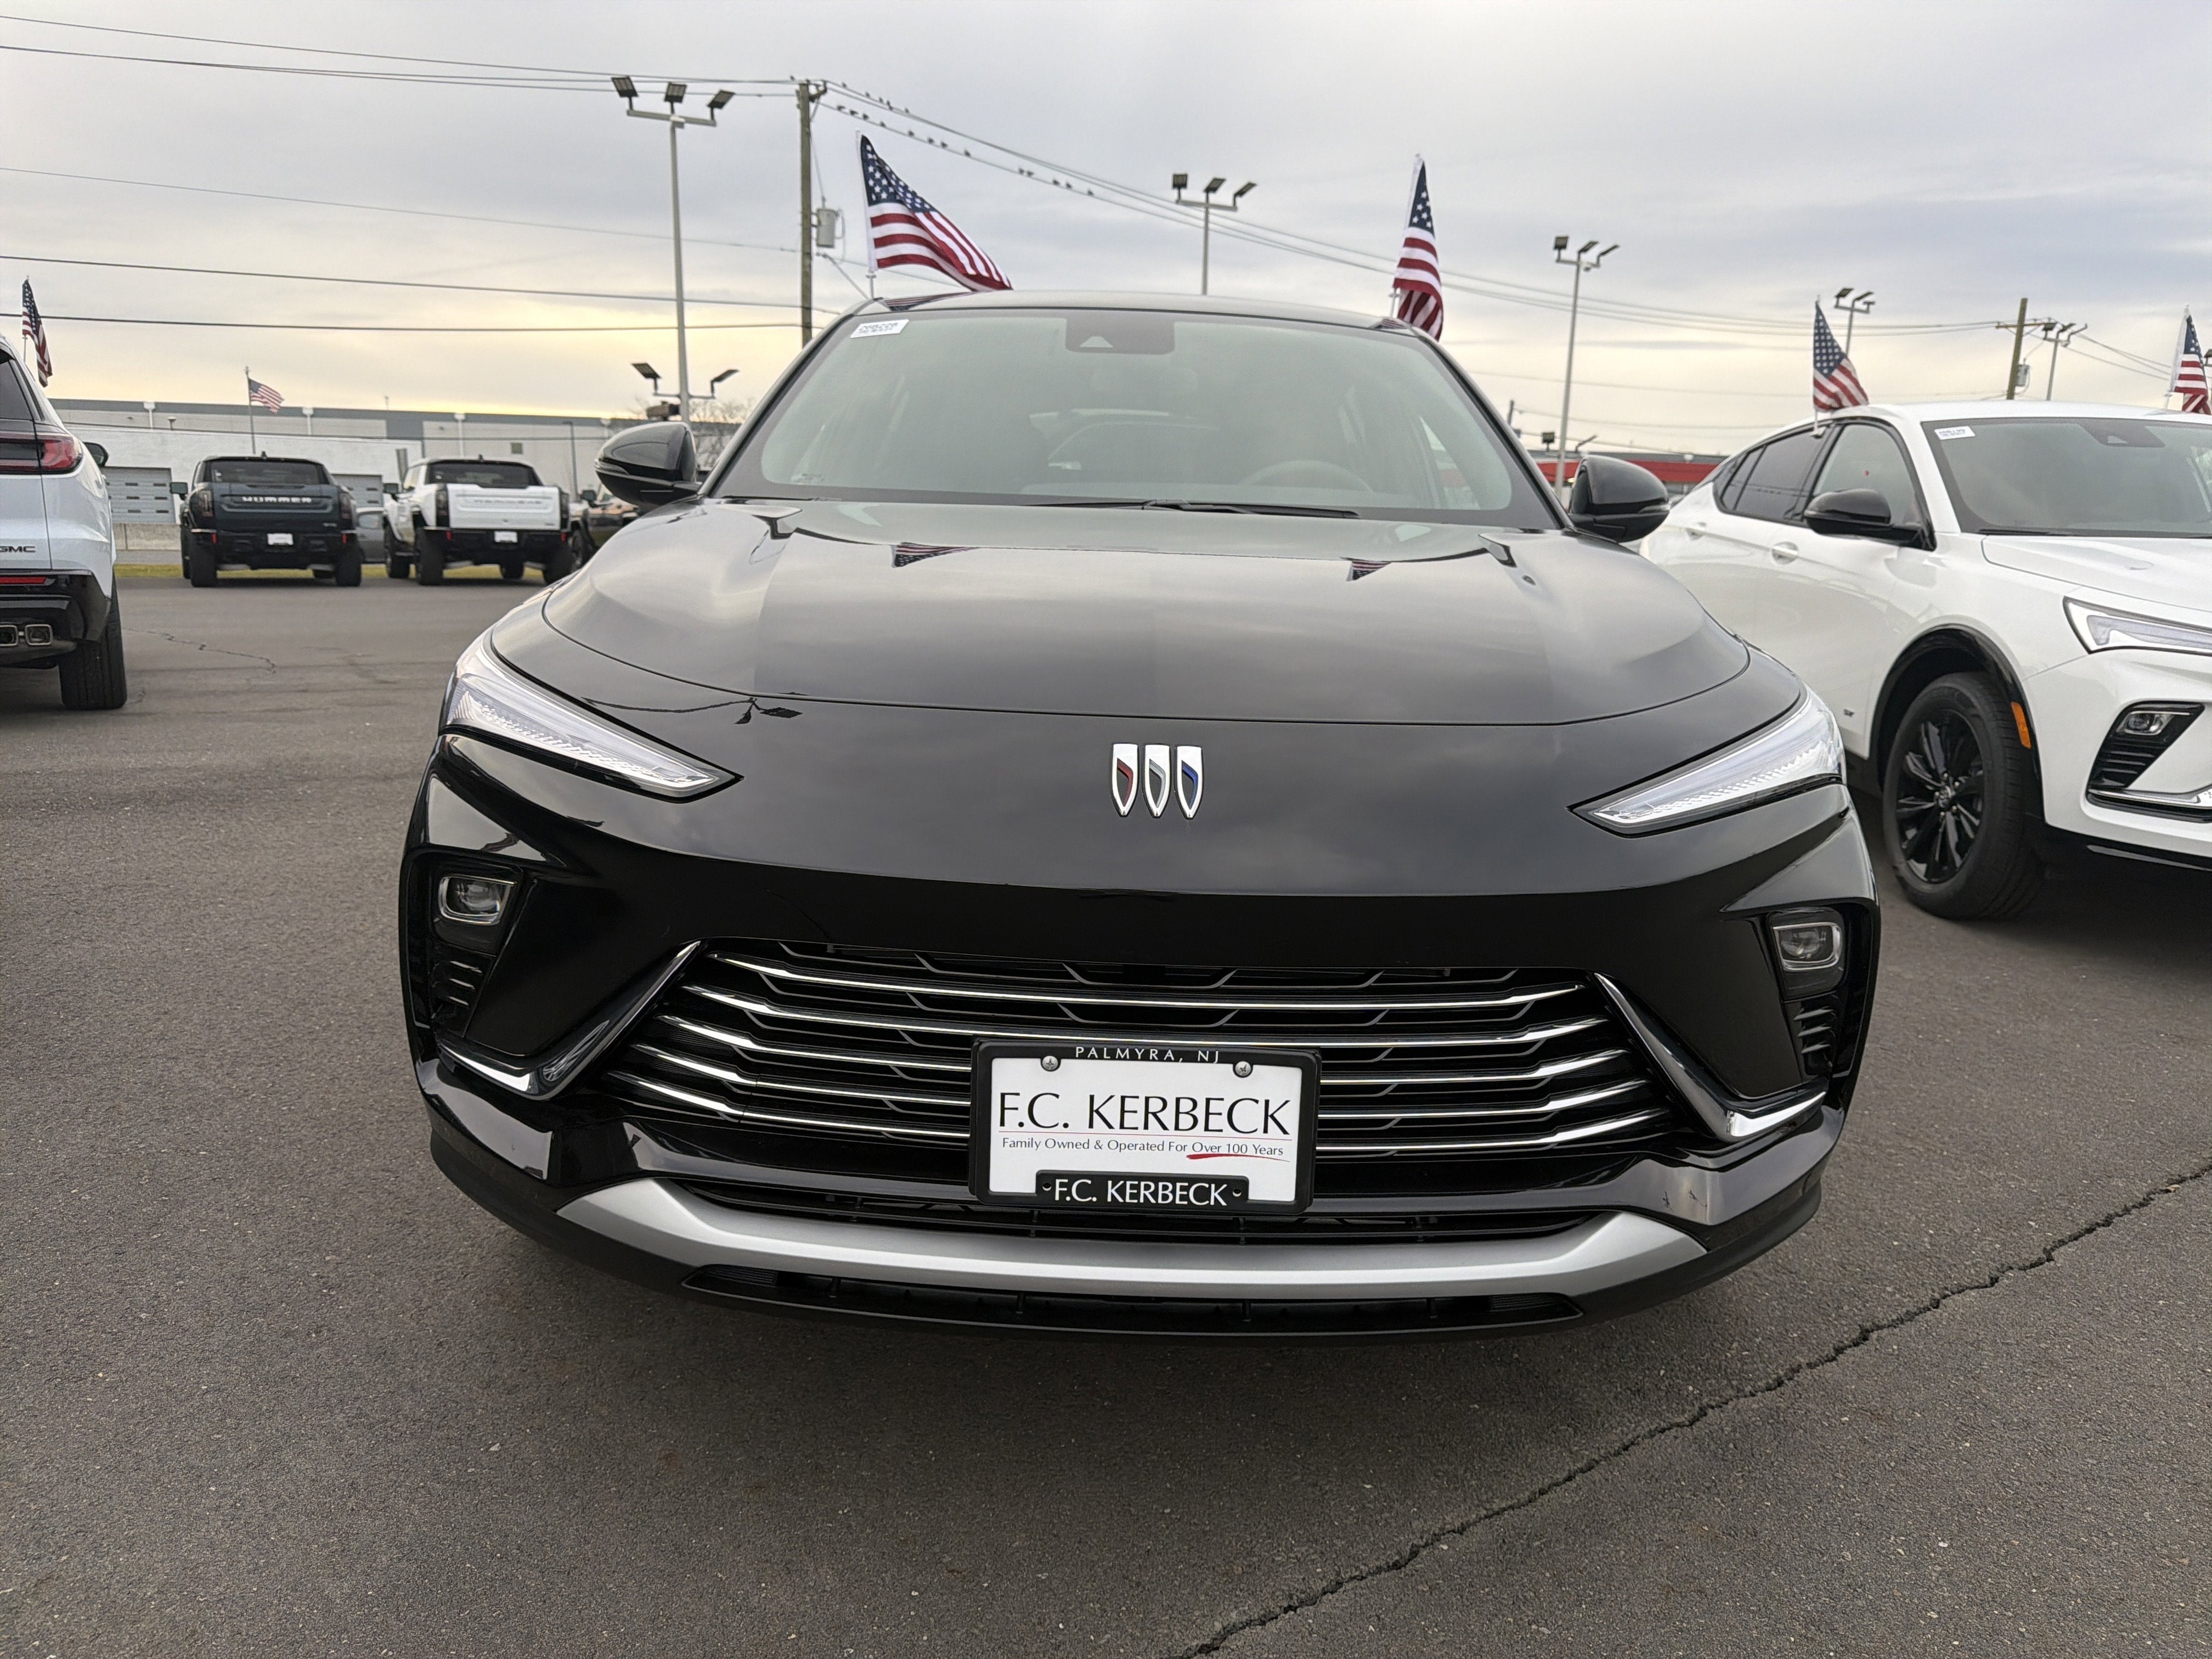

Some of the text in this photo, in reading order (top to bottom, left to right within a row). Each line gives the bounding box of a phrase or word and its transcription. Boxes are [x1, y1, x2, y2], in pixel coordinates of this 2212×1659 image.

[1075, 1046, 1220, 1064] PALMYRA, NJ
[999, 1092, 1291, 1135] F.C. KERBECK
[1002, 1137, 1284, 1156] Family Owned & Operated For Over 100 Years
[1054, 1178, 1228, 1206] F.C. KERBECK
